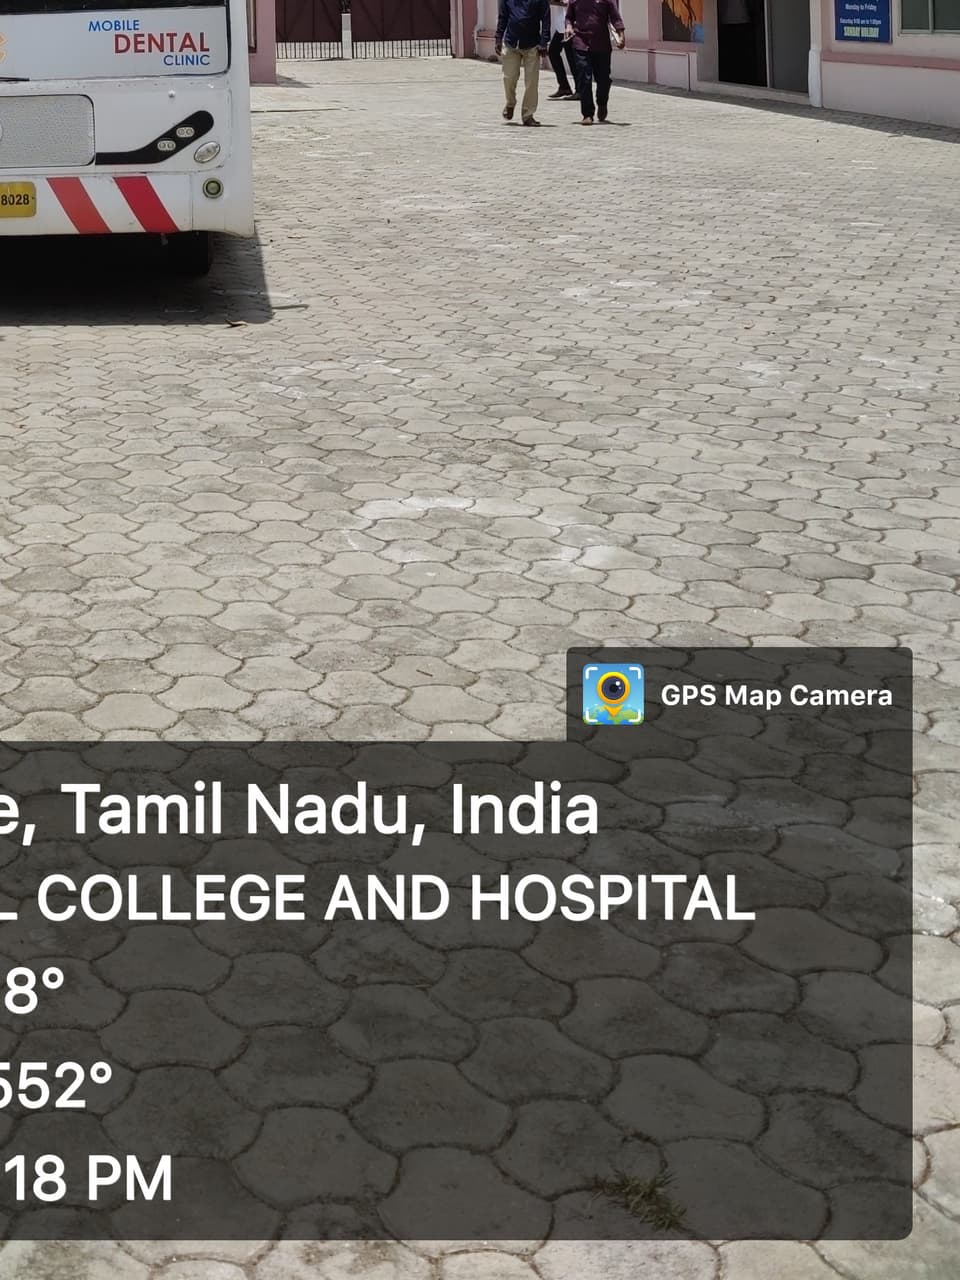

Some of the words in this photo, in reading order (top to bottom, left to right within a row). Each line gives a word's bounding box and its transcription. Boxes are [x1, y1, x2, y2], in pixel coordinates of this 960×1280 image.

[88, 19, 140, 32] MOBILE
[114, 32, 210, 54] DENTAL
[163, 54, 210, 66] CLINIC
[1, 193, 30, 206] 8028
